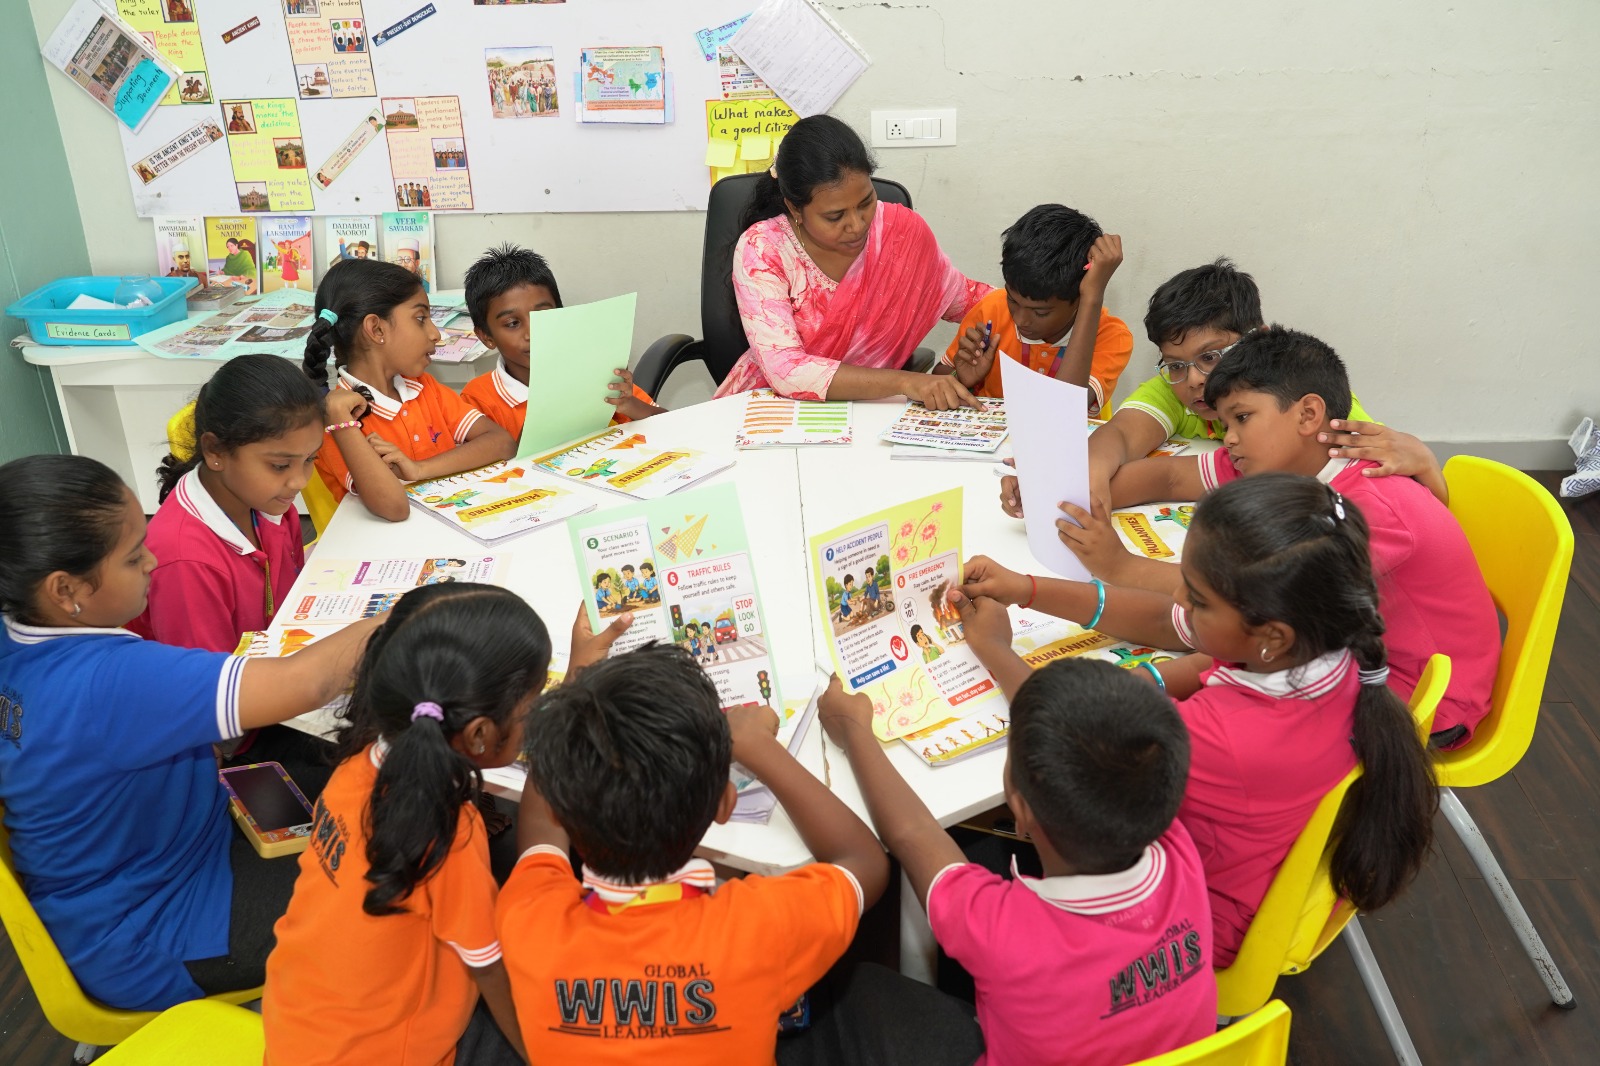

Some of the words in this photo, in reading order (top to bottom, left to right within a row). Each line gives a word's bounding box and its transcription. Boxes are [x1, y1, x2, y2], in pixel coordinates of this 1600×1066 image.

[411, 6, 434, 22] DEMOCRACY
[155, 30, 177, 40] People
[115, 74, 147, 112] Supporting
[714, 107, 748, 120] What
[755, 107, 793, 117] makes
[734, 122, 760, 140] good
[765, 123, 794, 132] Citize
[162, 142, 179, 157] ANCIENT
[178, 134, 193, 146] KING'S
[191, 127, 203, 138] RULE
[153, 160, 169, 173] BETTER
[168, 154, 179, 163] THAN
[177, 150, 185, 158] THE
[183, 141, 199, 155] PRESENT
[287, 178, 307, 186] rules
[55, 326, 89, 337] Evidence
[94, 329, 116, 337] Cards
[620, 454, 677, 484] HUMANITIES
[467, 492, 541, 518] HUMANITIES
[603, 531, 633, 543] SCENARIO
[836, 545, 846, 554] HELP
[847, 537, 867, 550] ACCIDENT
[868, 531, 883, 542] PEOPLE
[1126, 517, 1161, 554] HUMANITIES
[848, 550, 863, 559] someone
[855, 557, 864, 565] good
[670, 574, 675, 582] 6
[688, 567, 711, 578] TRAFFIC
[713, 563, 731, 573] RULES
[909, 572, 918, 580] FIRE
[919, 562, 945, 576] EMERGENCY
[693, 580, 707, 588] traffic
[682, 591, 700, 600] yourself
[711, 586, 725, 594] others
[736, 599, 753, 610] STOP
[904, 601, 912, 609] Call
[739, 611, 755, 621] LOOK
[906, 609, 914, 618] 101
[744, 623, 754, 632] GO
[1026, 634, 1108, 665] HUMANITIES
[712, 668, 730, 676] crossing
[644, 963, 711, 979] GLOBAL
[1109, 930, 1201, 1005] WWIS
[1136, 977, 1182, 1007] LEADER
[555, 978, 717, 1026] WWIS
[603, 1025, 675, 1040] LEADER
